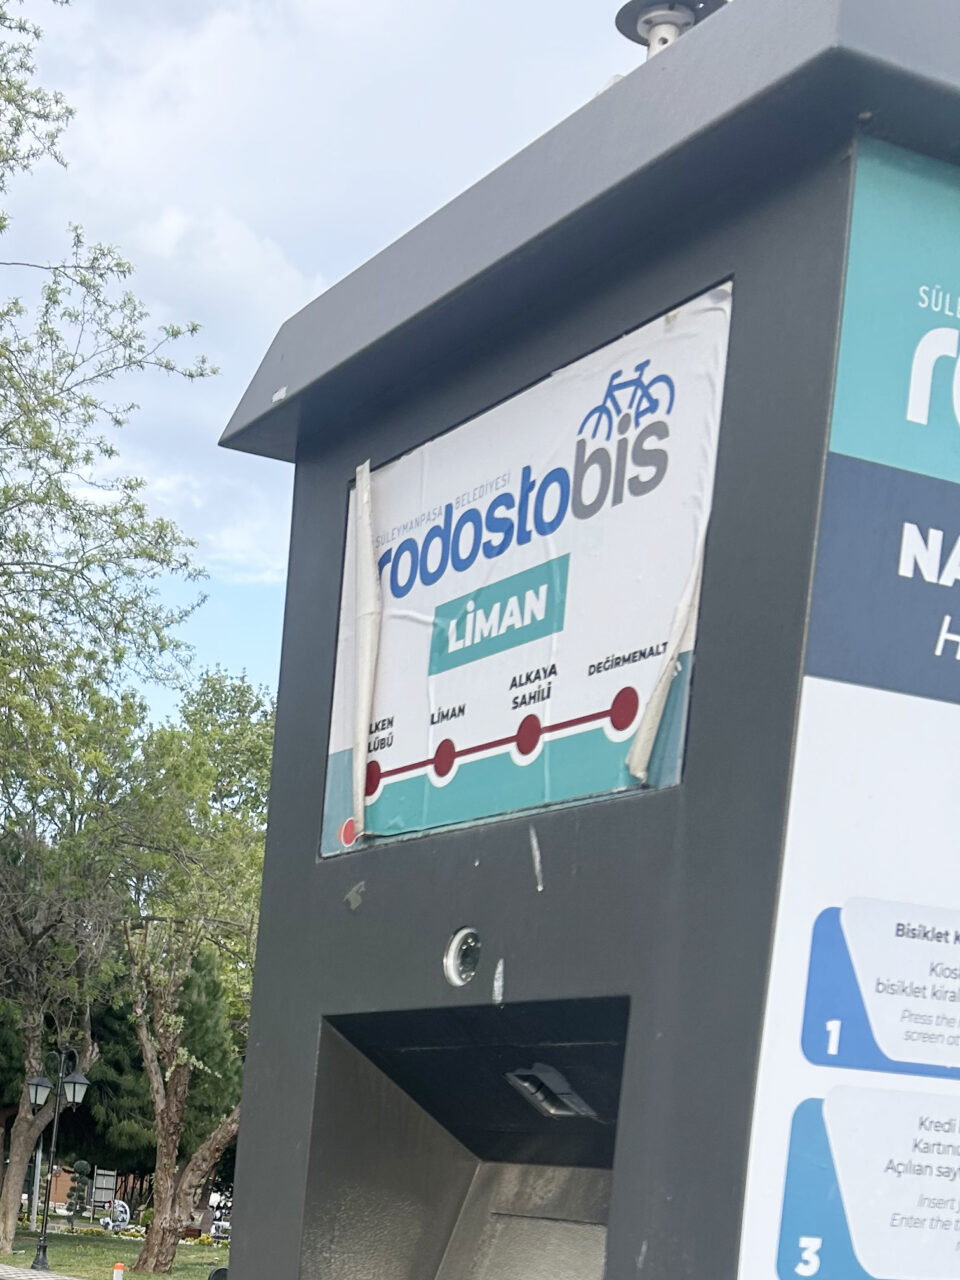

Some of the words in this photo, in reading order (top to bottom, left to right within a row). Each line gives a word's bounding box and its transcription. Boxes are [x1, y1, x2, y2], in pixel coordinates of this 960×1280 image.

[906, 327, 960, 427] r
[448, 584, 548, 653] LİMAN
[509, 663, 558, 691] ALKAYA
[511, 682, 553, 710] SAHİLİ
[430, 704, 466, 725] LİMAN
[895, 922, 950, 943] Bisiklet
[875, 977, 928, 999] bisiklet
[825, 1018, 842, 1056] 1
[918, 1116, 957, 1133] Kredi
[884, 1159, 934, 1178] Açılan
[794, 1235, 823, 1277] 3
